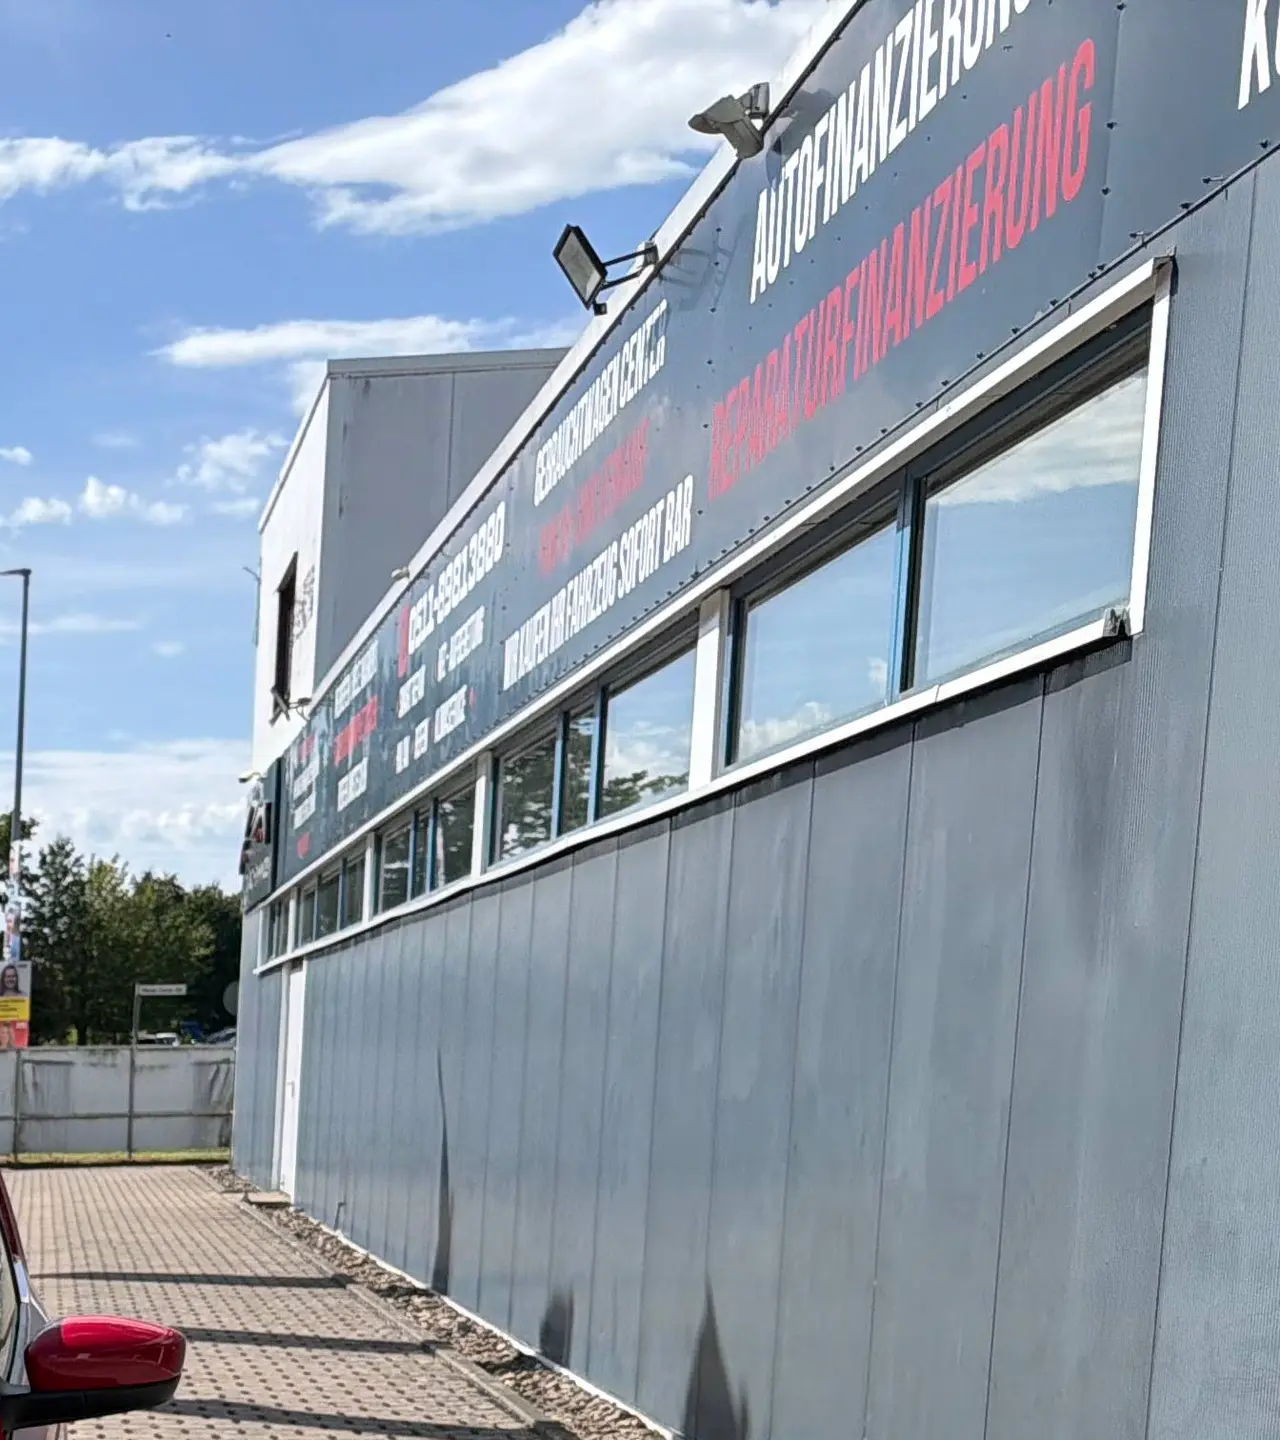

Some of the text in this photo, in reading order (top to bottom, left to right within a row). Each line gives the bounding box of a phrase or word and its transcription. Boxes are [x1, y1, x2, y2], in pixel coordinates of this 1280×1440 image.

[619, 298, 667, 409] CENTER
[707, 38, 1096, 503] REPARATURFINANZIERUNG
[564, 540, 617, 643] FAHRZEUG
[617, 505, 665, 600] SOFORT
[663, 474, 695, 565] BAR
